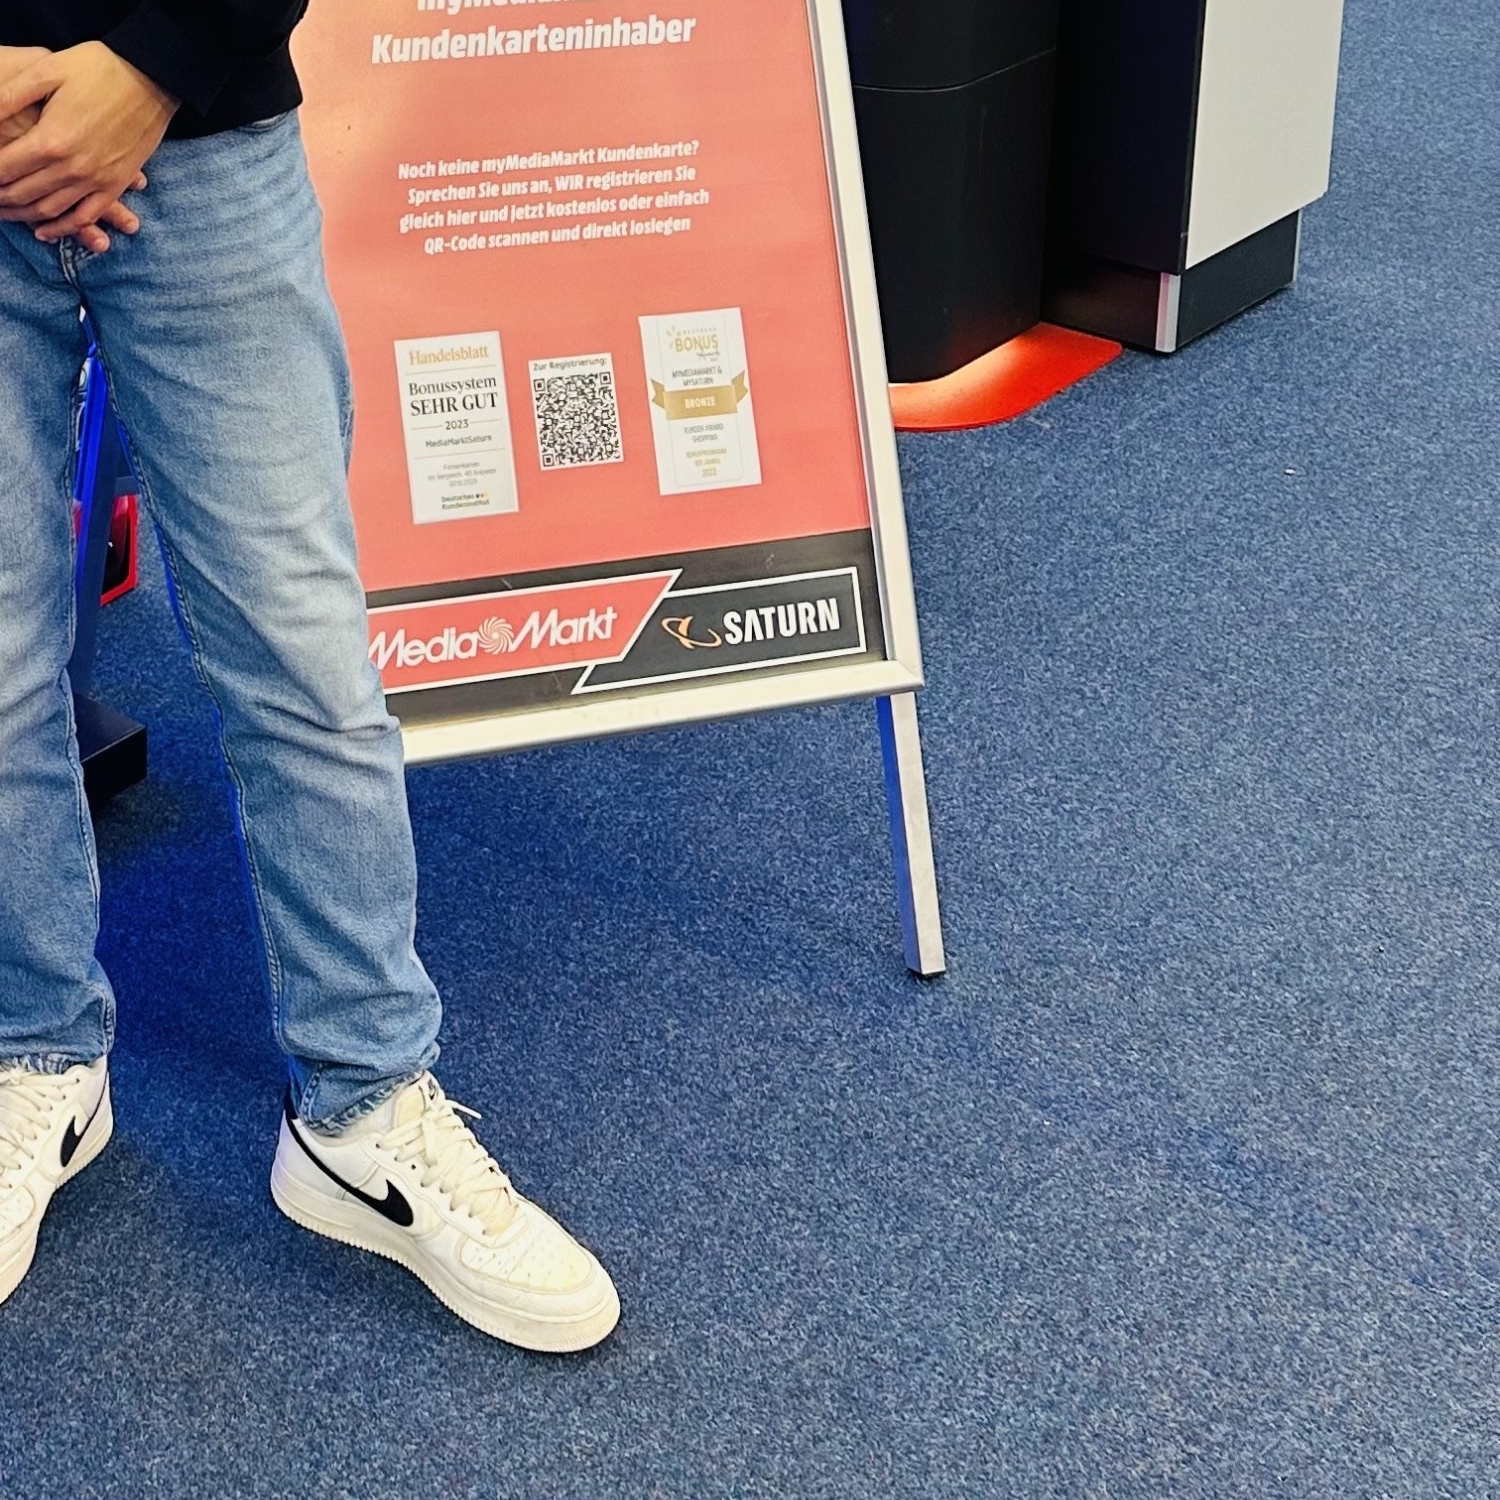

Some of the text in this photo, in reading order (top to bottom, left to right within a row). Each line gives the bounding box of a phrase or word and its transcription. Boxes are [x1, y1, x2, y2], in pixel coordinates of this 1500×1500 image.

[371, 14, 697, 64] Kundenkarteninhaber
[398, 140, 699, 180] Noch keine myMediaMarkt Kundenkarte?
[408, 164, 696, 206] Sprechen Sie uns an, WIR registrieren Sie
[400, 189, 709, 233] gleich hier und jetzt kostenlos oder einfach
[424, 216, 691, 255] QR-Code scannen und direkt loslegen
[408, 345, 490, 366] Handelsblatt
[675, 334, 719, 353] BONUS
[533, 356, 607, 371] Zur Registrierung:
[408, 375, 497, 398] Bonussystem
[410, 392, 498, 417] SEHR GUT
[445, 418, 469, 431] 2023
[425, 434, 492, 448] MediaMarktSaturn
[724, 598, 841, 645] SATURN
[368, 606, 618, 670] Media Markt
